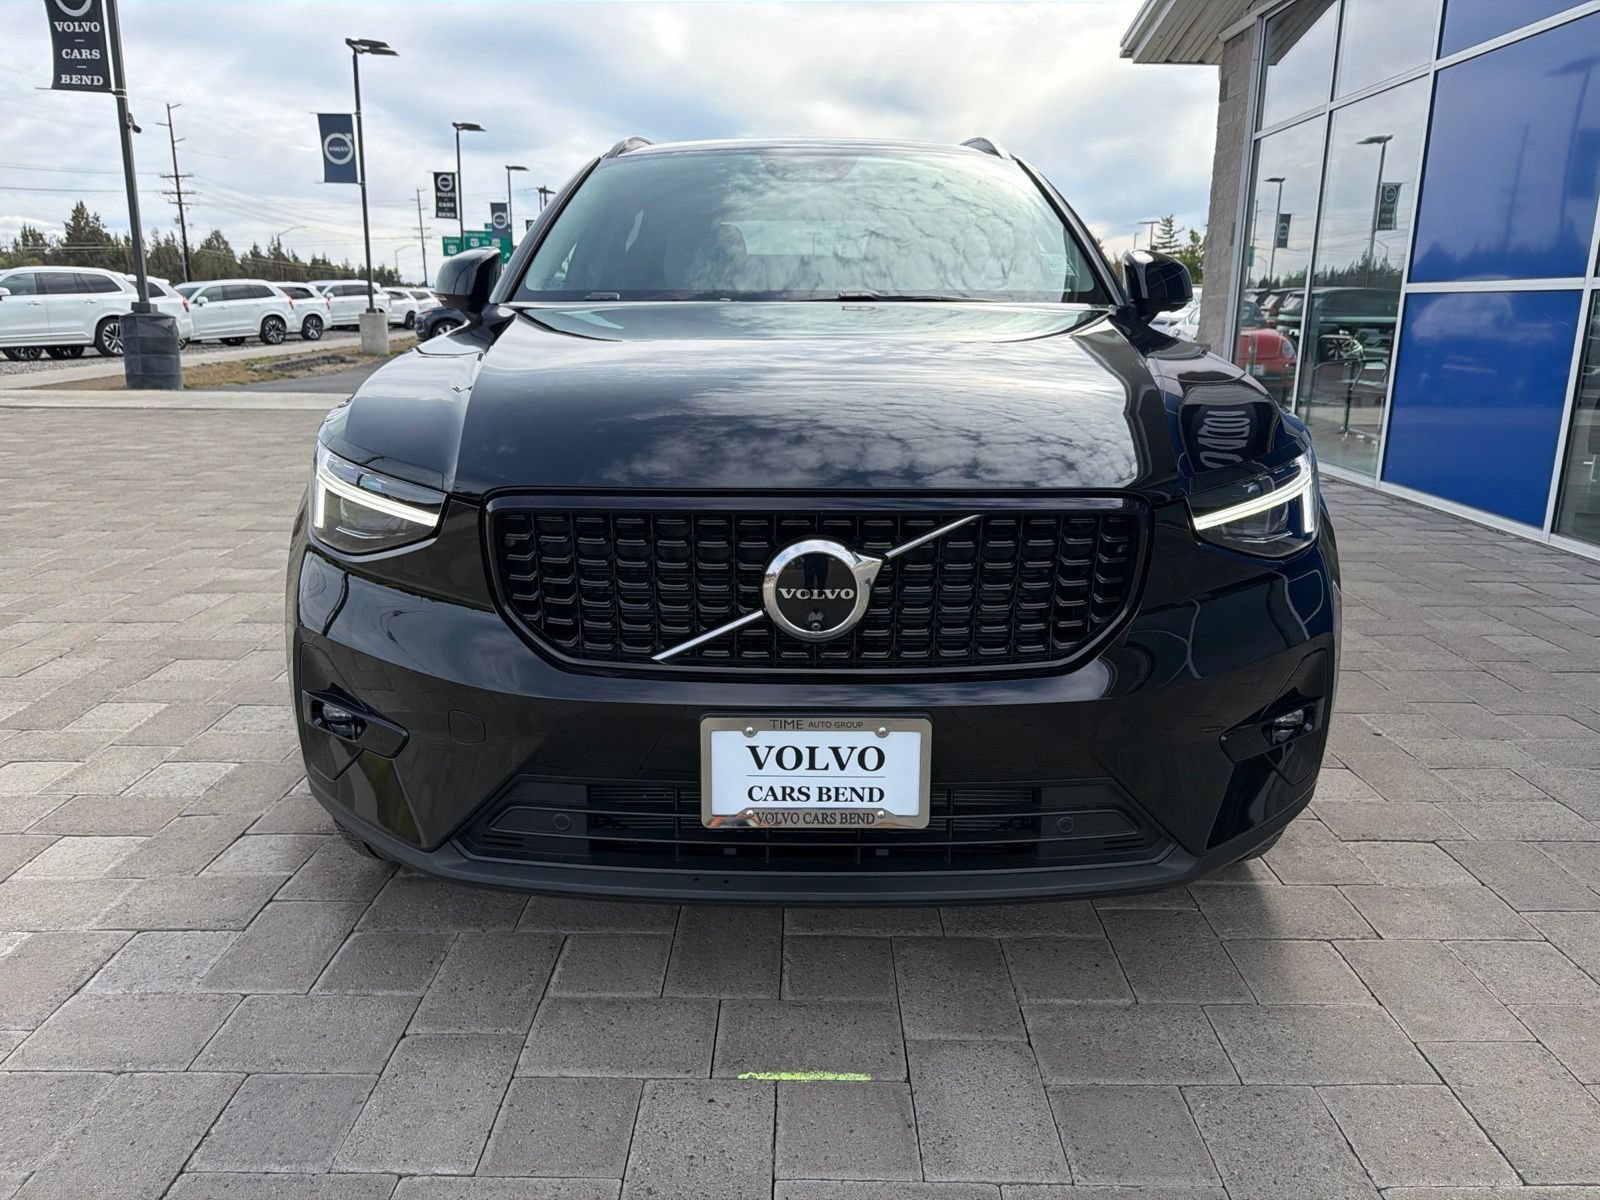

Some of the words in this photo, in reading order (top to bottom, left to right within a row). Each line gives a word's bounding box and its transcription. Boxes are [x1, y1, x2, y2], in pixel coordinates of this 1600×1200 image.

[53, 21, 100, 32] VOLVO
[61, 48, 100, 59] CARS
[60, 74, 103, 85] BEND
[778, 588, 855, 600] VOLVO
[769, 720, 804, 730] TIME
[808, 721, 832, 729] AUTO
[834, 721, 864, 729] GROUP
[745, 745, 886, 772] VOLVO
[747, 785, 811, 802] CARS
[816, 786, 885, 803] BEND
[756, 812, 800, 825] VOLVO
[803, 812, 837, 825] CARS
[838, 813, 876, 825] BEND
